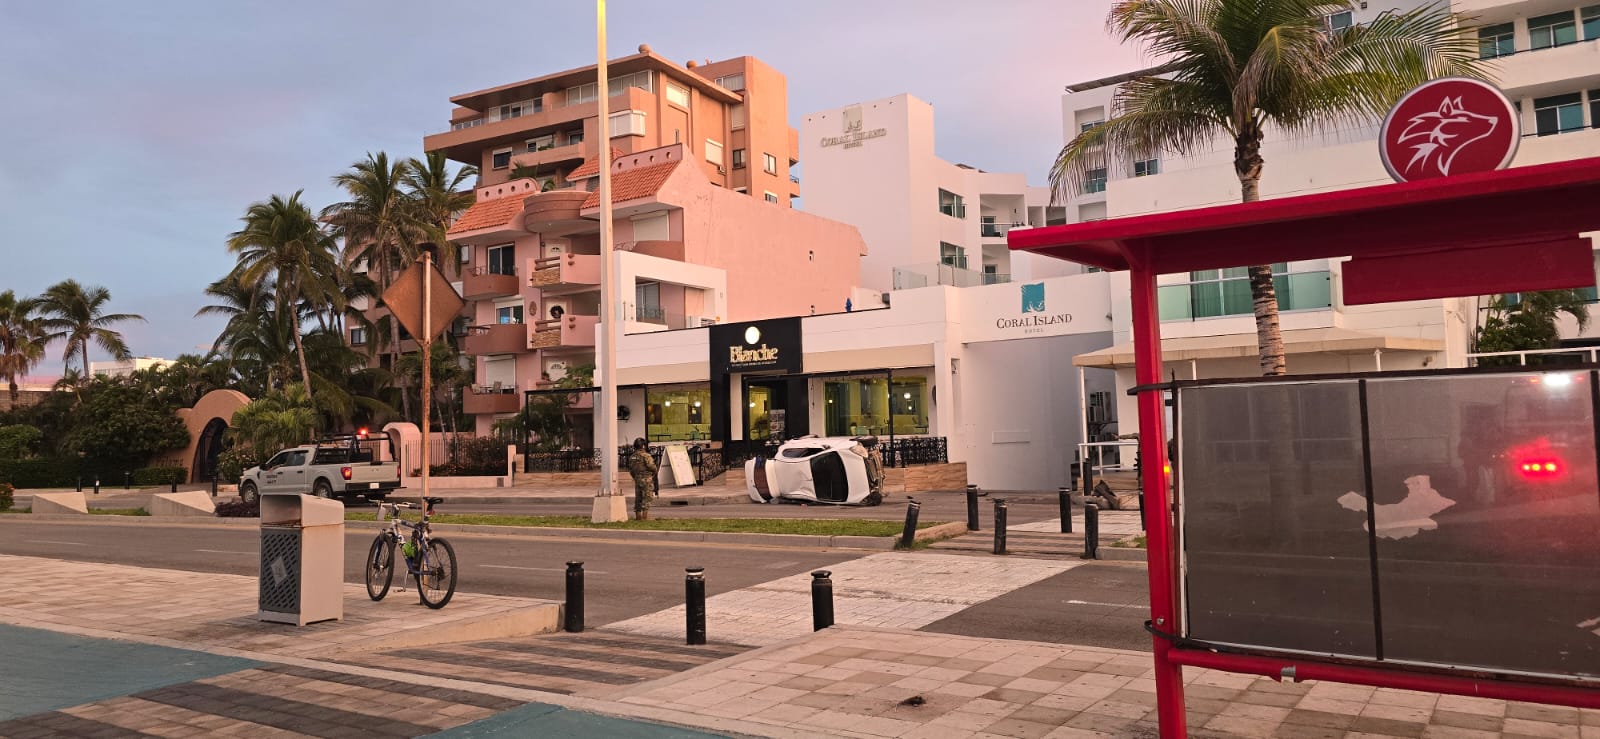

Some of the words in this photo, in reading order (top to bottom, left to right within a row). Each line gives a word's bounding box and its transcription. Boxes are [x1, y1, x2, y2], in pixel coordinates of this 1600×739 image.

[852, 128, 886, 141] ISLAND
[997, 317, 1032, 329] CORAL
[1033, 314, 1072, 326] ISLAND
[730, 344, 778, 362] Blanche
